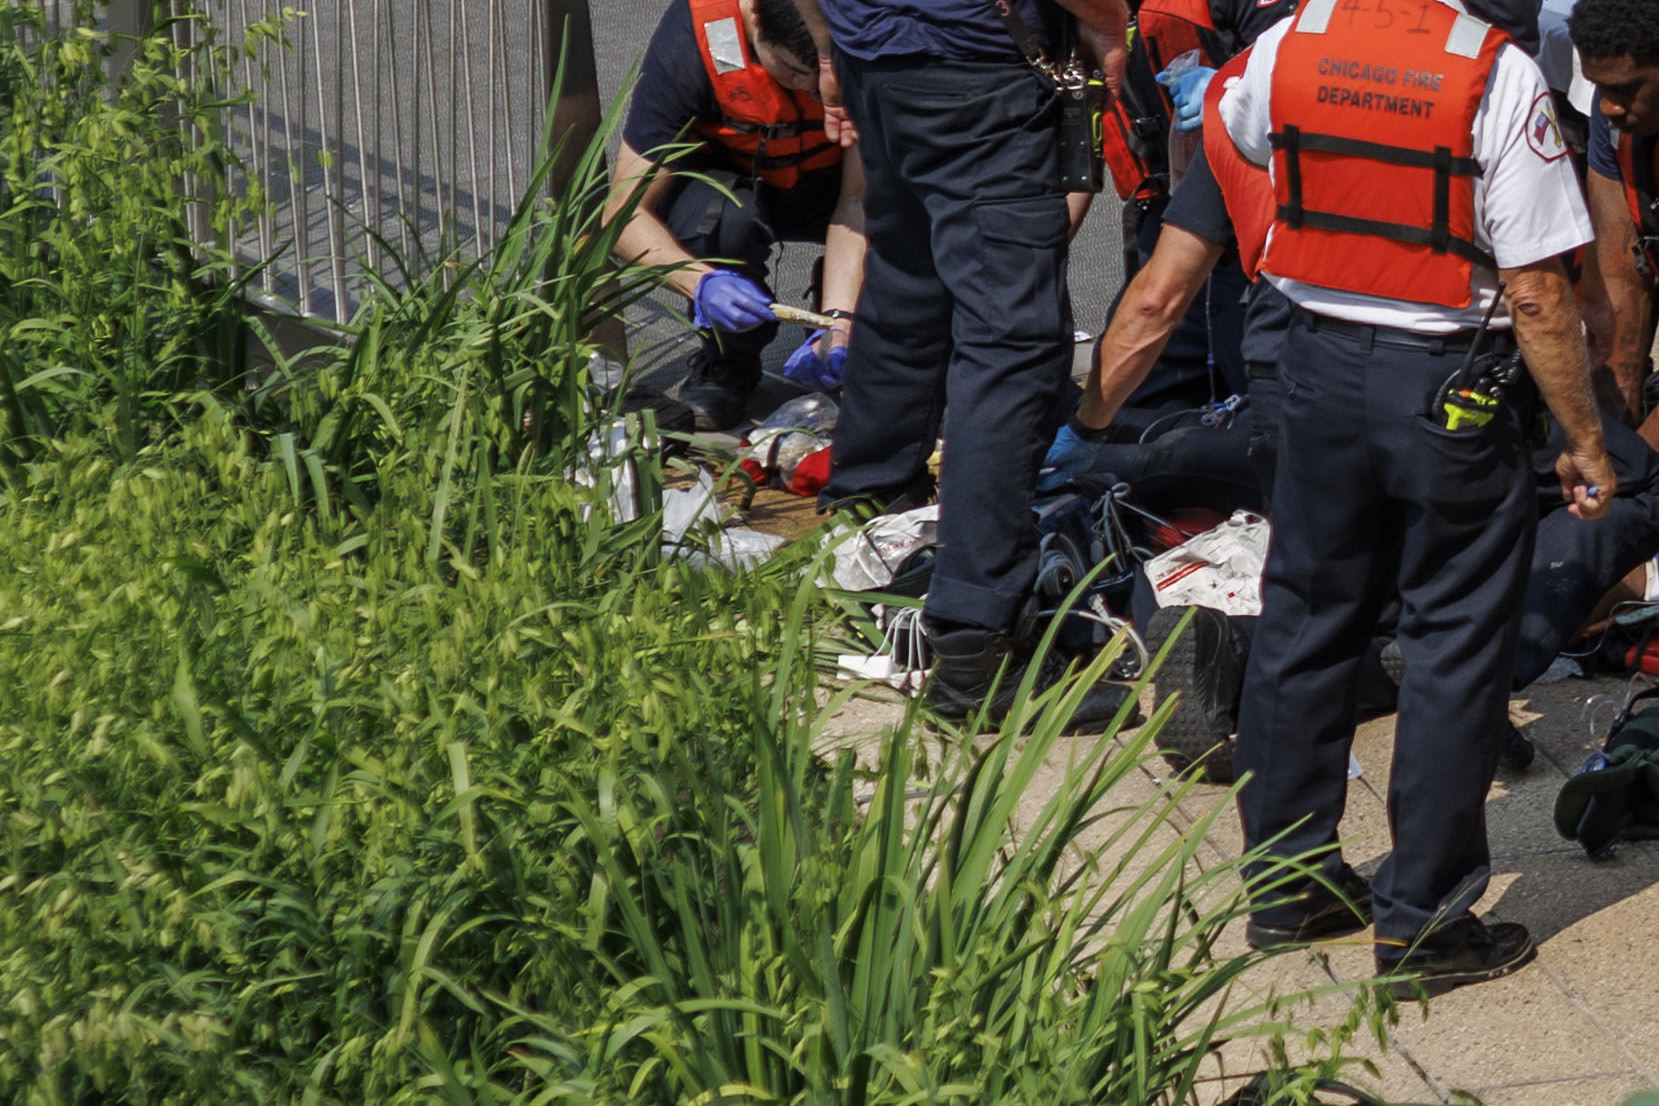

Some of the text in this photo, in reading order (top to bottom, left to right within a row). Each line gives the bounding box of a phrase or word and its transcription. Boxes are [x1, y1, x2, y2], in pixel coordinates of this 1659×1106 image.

[995, 0, 1010, 17] 3
[1318, 57, 1445, 93] CHICAGO FIRE
[1316, 85, 1435, 119] DEPARTMENT
